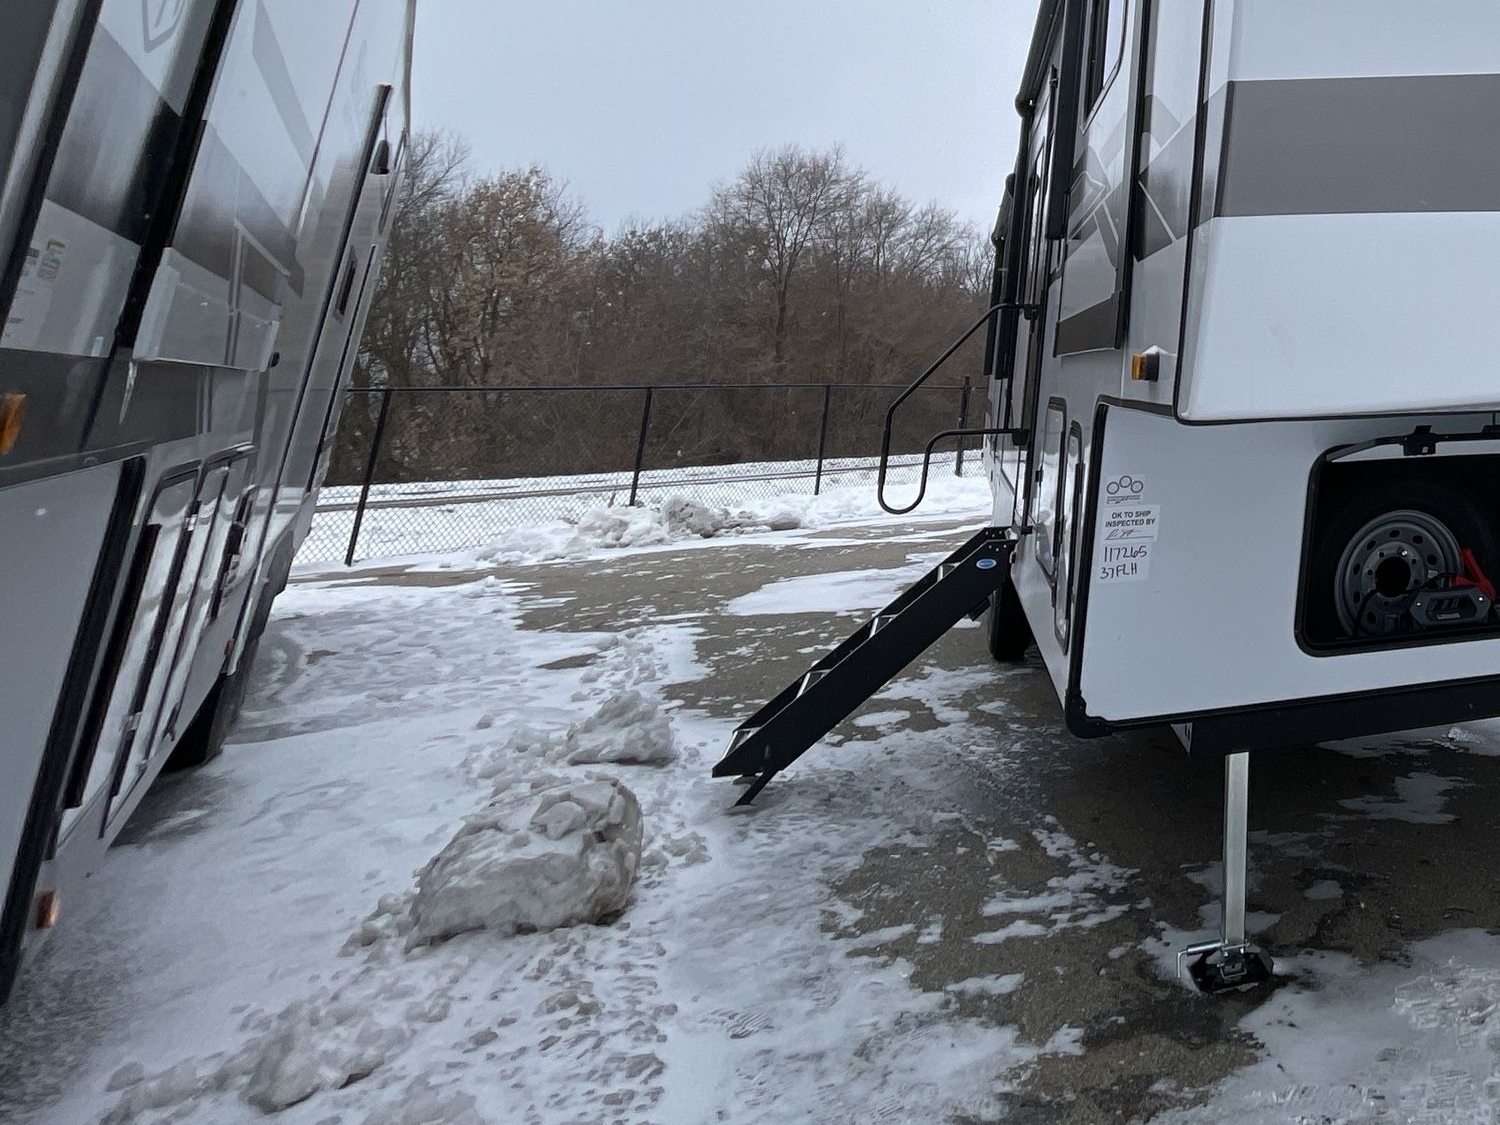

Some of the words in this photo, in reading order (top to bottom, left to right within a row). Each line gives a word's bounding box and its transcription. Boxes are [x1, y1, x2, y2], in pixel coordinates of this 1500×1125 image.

[1105, 519, 1145, 528] INSPECTED
[1104, 545, 1147, 563] 117265
[1100, 562, 1138, 580] 37FLH
